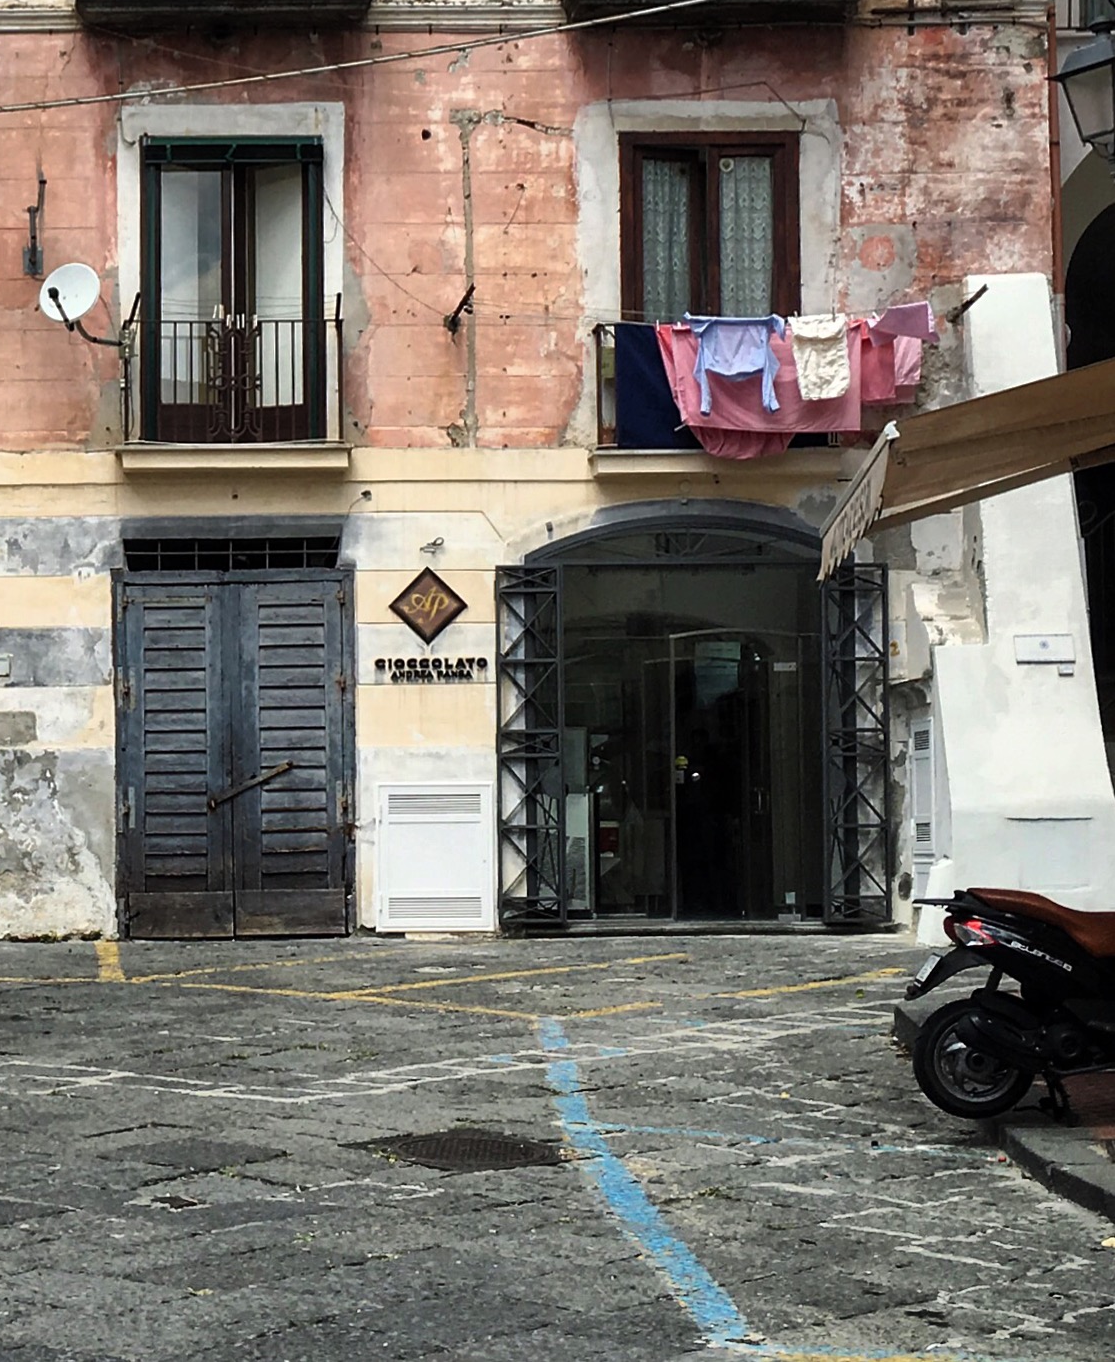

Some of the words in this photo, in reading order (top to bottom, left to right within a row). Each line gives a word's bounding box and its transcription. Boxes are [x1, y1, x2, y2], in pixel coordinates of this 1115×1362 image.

[374, 657, 488, 669] CIOCCOLATO
[390, 669, 434, 680] ANDREA
[436, 669, 473, 680] PANSA
